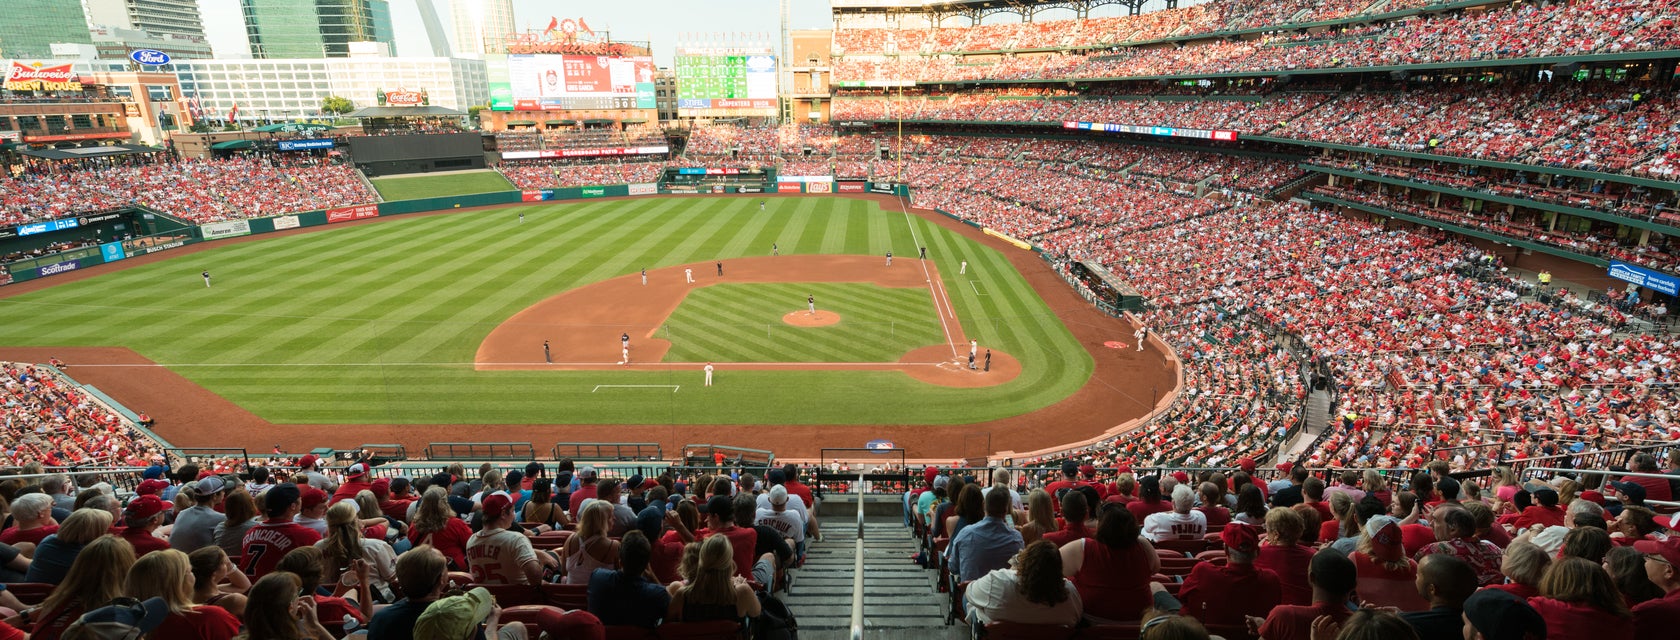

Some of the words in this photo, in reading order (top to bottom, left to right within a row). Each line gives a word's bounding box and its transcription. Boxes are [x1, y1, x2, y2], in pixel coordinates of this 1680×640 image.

[139, 50, 164, 63] Ford
[12, 66, 78, 80] Budweiser
[6, 81, 41, 91] BREW
[43, 81, 83, 91] HOUSE
[390, 92, 418, 103] Coca-Cola
[163, 241, 184, 250] STADIUM
[41, 262, 76, 276] Scottrade
[1171, 523, 1202, 535] PUJOLS
[467, 543, 501, 561] FOWLER
[245, 543, 268, 577] 7
